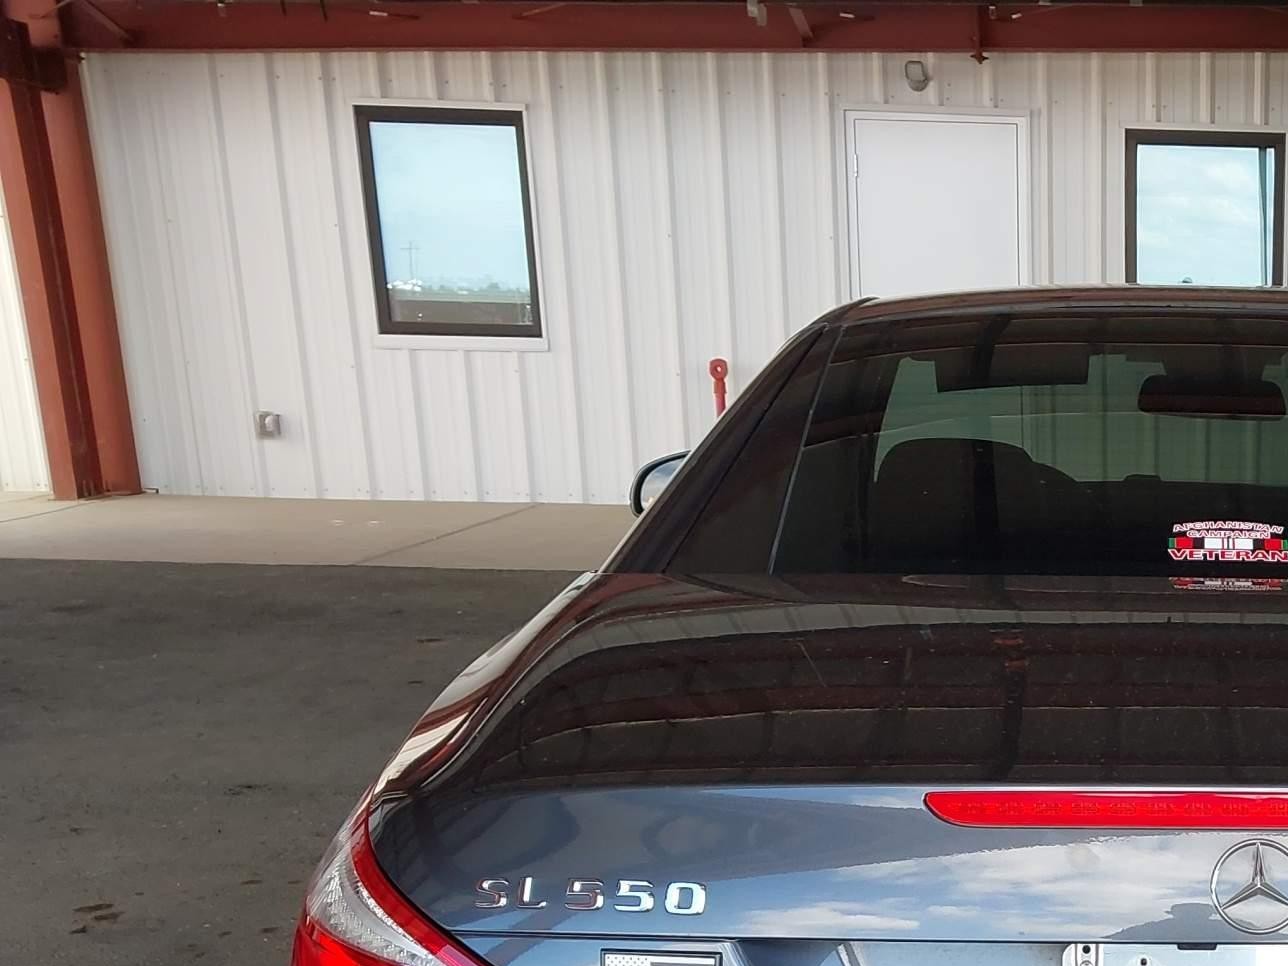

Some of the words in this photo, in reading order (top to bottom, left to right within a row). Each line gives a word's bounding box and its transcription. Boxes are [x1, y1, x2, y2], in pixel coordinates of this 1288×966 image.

[1173, 521, 1284, 535] AFGHANISTAN
[1187, 530, 1270, 539] CAMPAIGN
[475, 876, 547, 909] SL
[565, 879, 707, 915] 550
